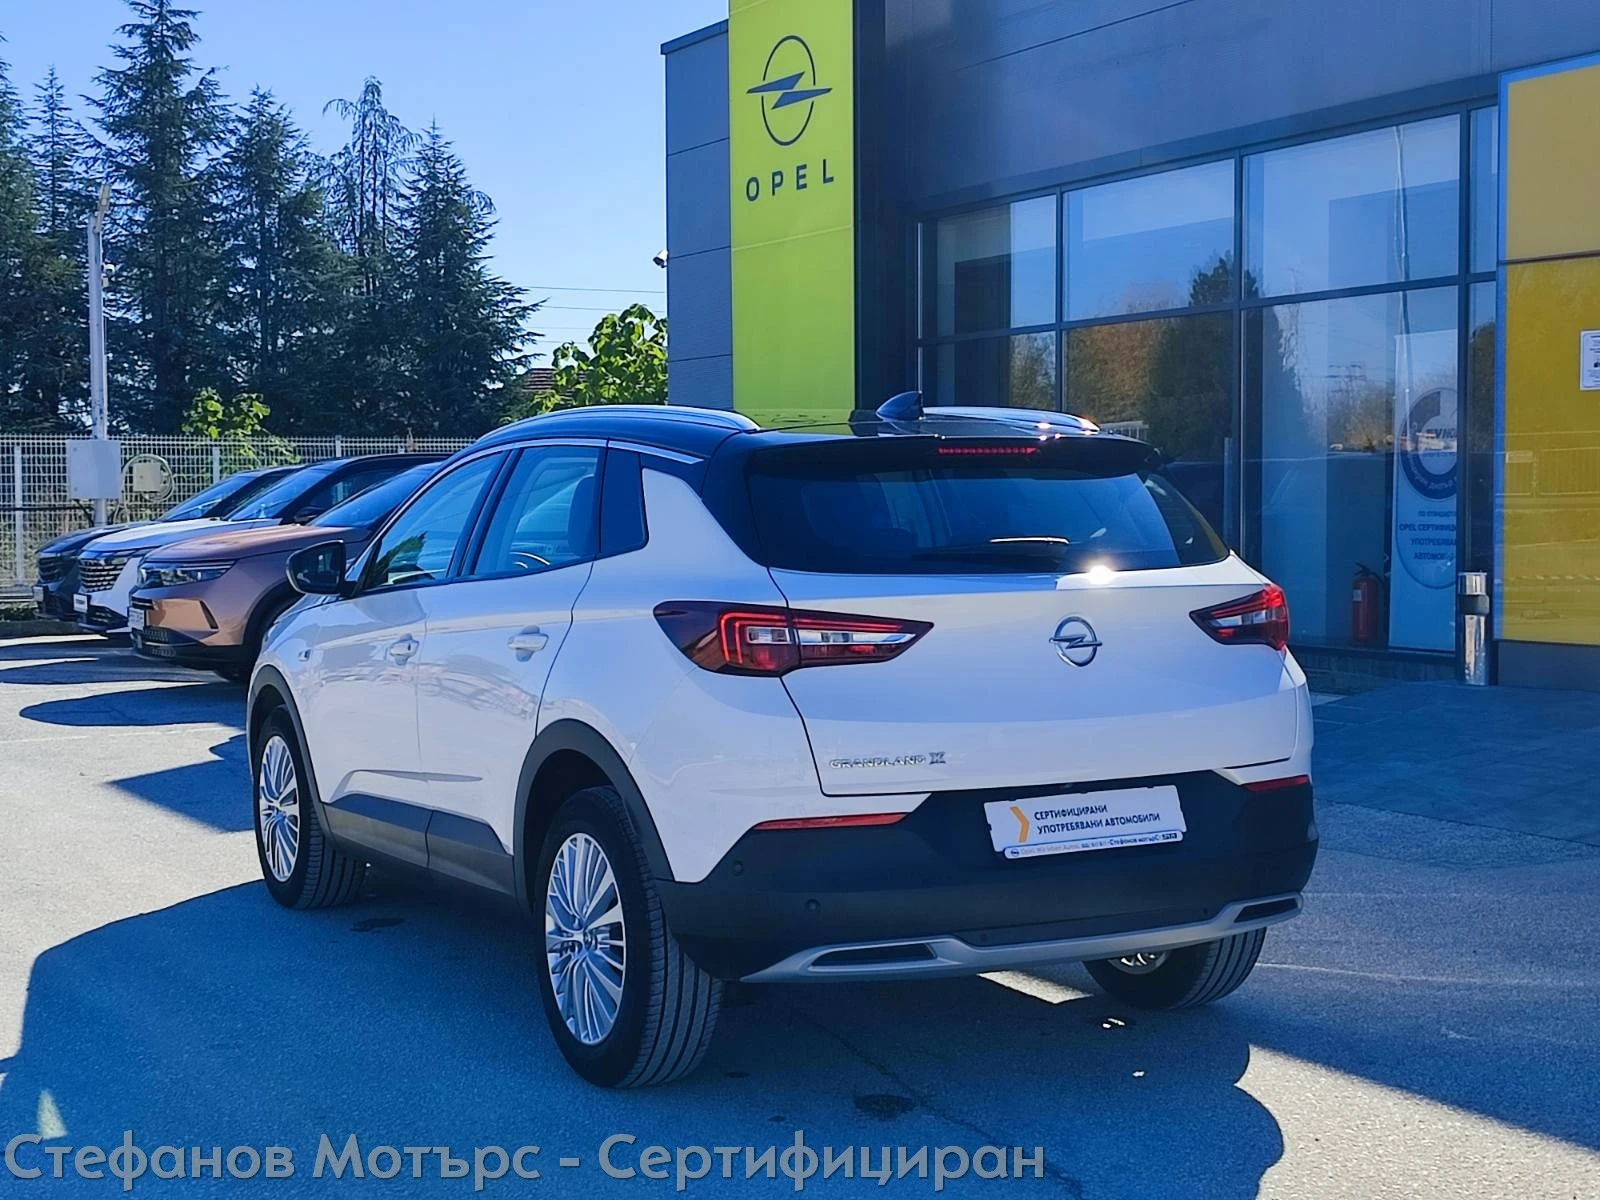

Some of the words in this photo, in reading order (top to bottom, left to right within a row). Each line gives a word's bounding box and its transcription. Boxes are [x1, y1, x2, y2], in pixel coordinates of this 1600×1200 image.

[746, 158, 834, 202] OPEL
[829, 754, 926, 769] GRANDLAND
[928, 751, 946, 765] X
[1034, 804, 1108, 821] СЕРТИФИЦИРАНИ
[1037, 819, 1103, 835] УПОТРЕБЯВАНИ
[1104, 812, 1161, 828] АВТОМОБИЛИ
